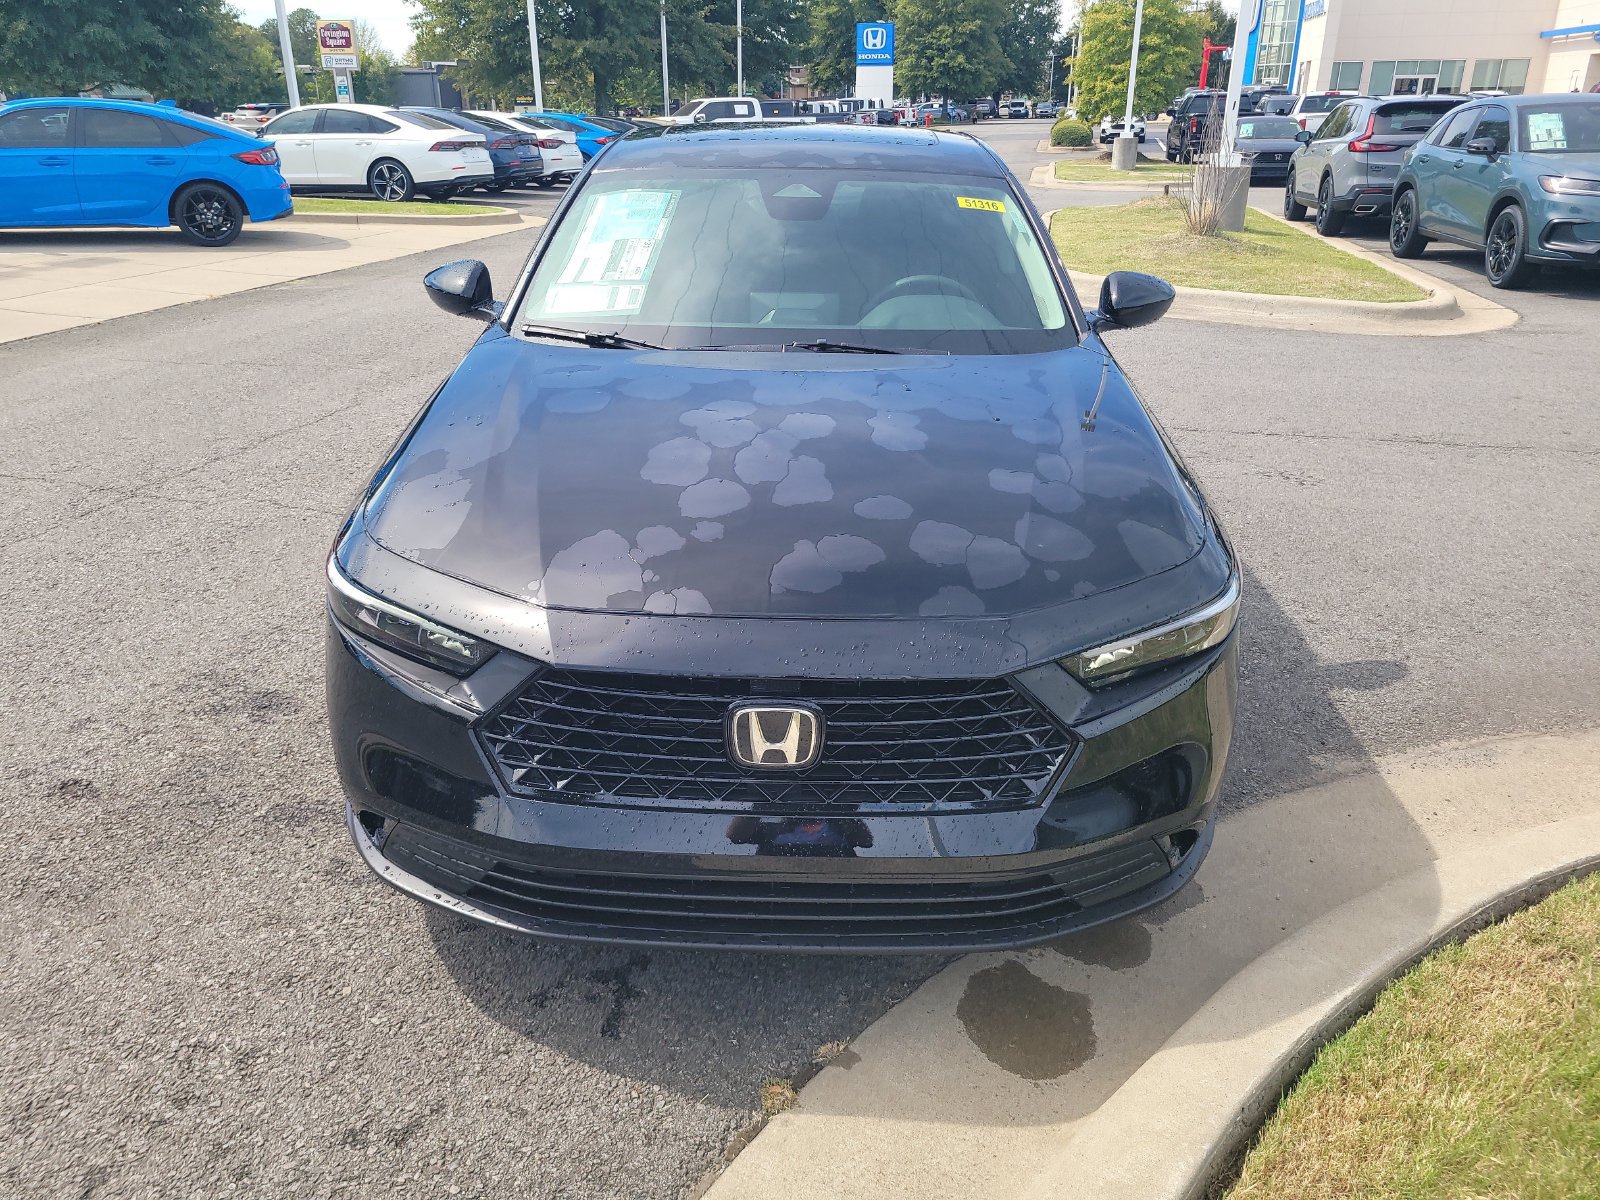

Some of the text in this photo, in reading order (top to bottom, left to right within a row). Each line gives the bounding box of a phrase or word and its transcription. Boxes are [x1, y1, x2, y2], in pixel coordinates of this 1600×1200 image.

[320, 29, 350, 39] Covington
[325, 38, 346, 47] Square
[964, 199, 999, 210] 51316
